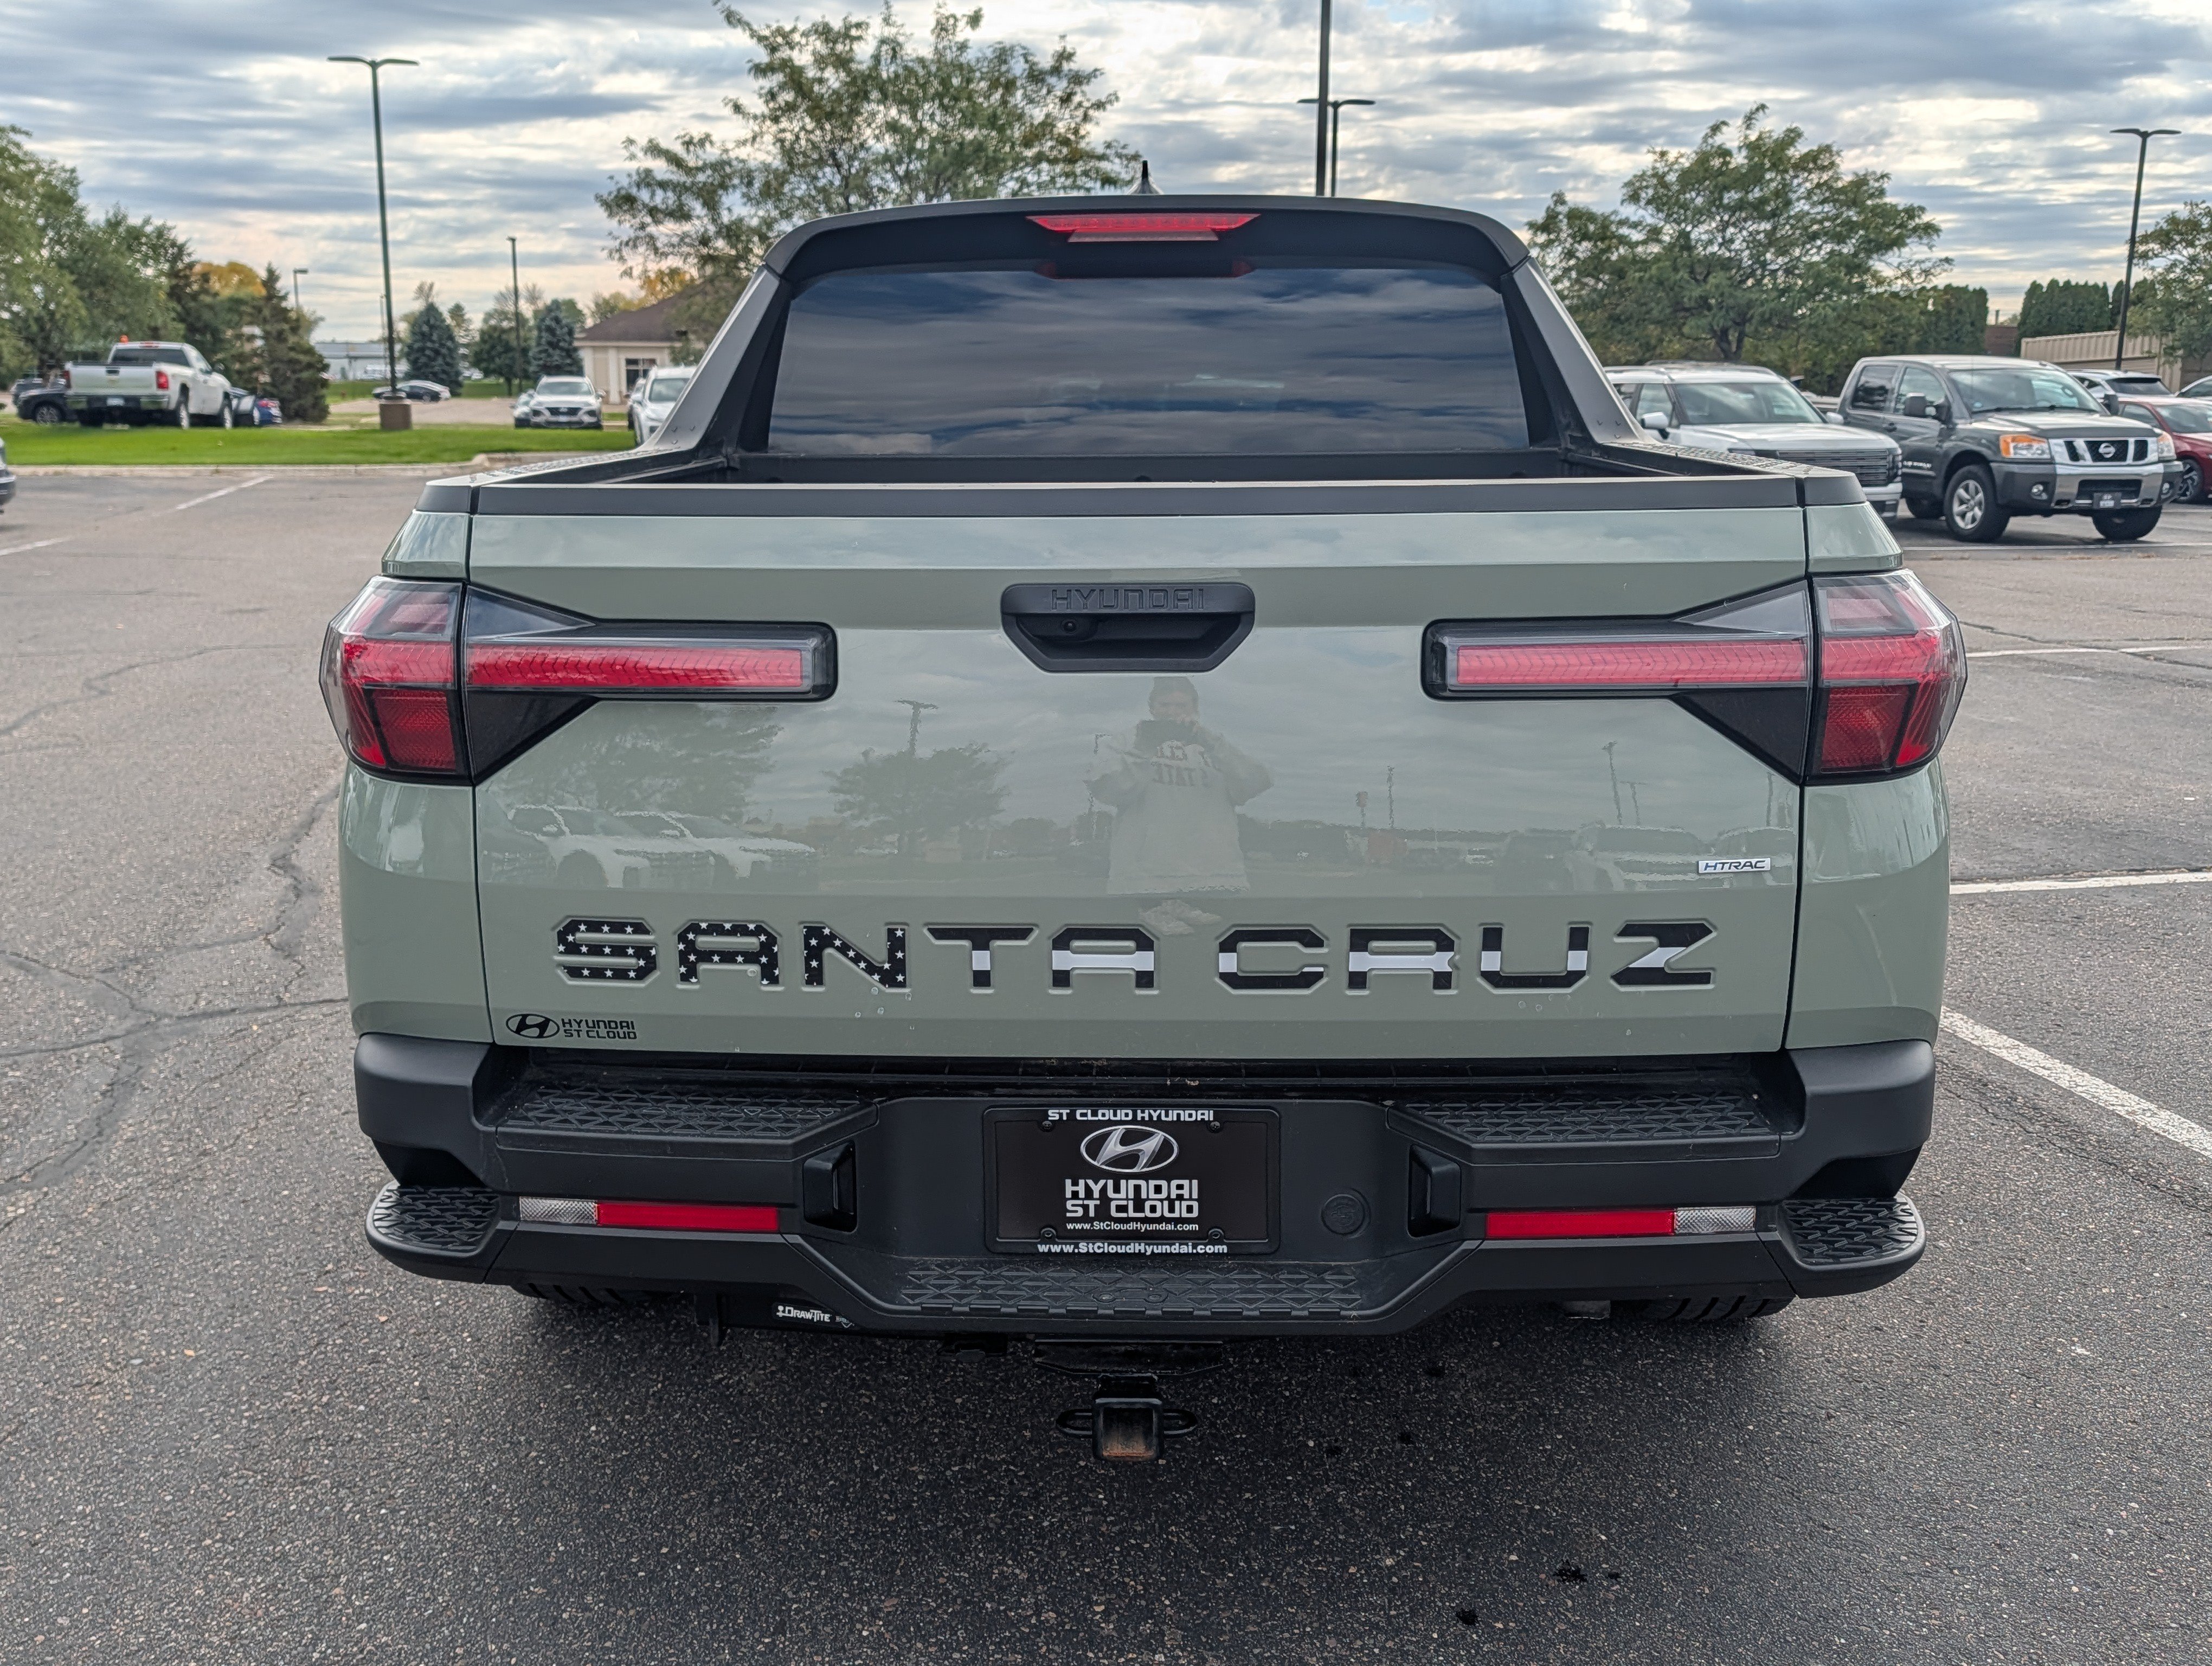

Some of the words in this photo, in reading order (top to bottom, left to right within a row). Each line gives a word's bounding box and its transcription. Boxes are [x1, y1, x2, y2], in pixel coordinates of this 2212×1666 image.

[1051, 588, 1205, 611] HYUNDAI
[1703, 860, 1766, 871] HTRAC
[554, 917, 1157, 993] SANTA
[1216, 920, 1716, 993] CRUZ
[561, 1017, 635, 1030] HYUNDAI
[563, 1028, 583, 1038] ST
[586, 1029, 637, 1040] CLOUD
[1047, 1109, 1070, 1121] ST
[1076, 1109, 1133, 1121] CLOUD
[1137, 1109, 1214, 1121] HYUNDAI
[1065, 1179, 1199, 1199] HYUNDAI
[1066, 1200, 1100, 1218] ST
[1110, 1200, 1199, 1218] CLOUD
[1066, 1221, 1199, 1232] www.StCloudHyundai.com
[1037, 1241, 1228, 1256] www.StCloudHyundai.com
